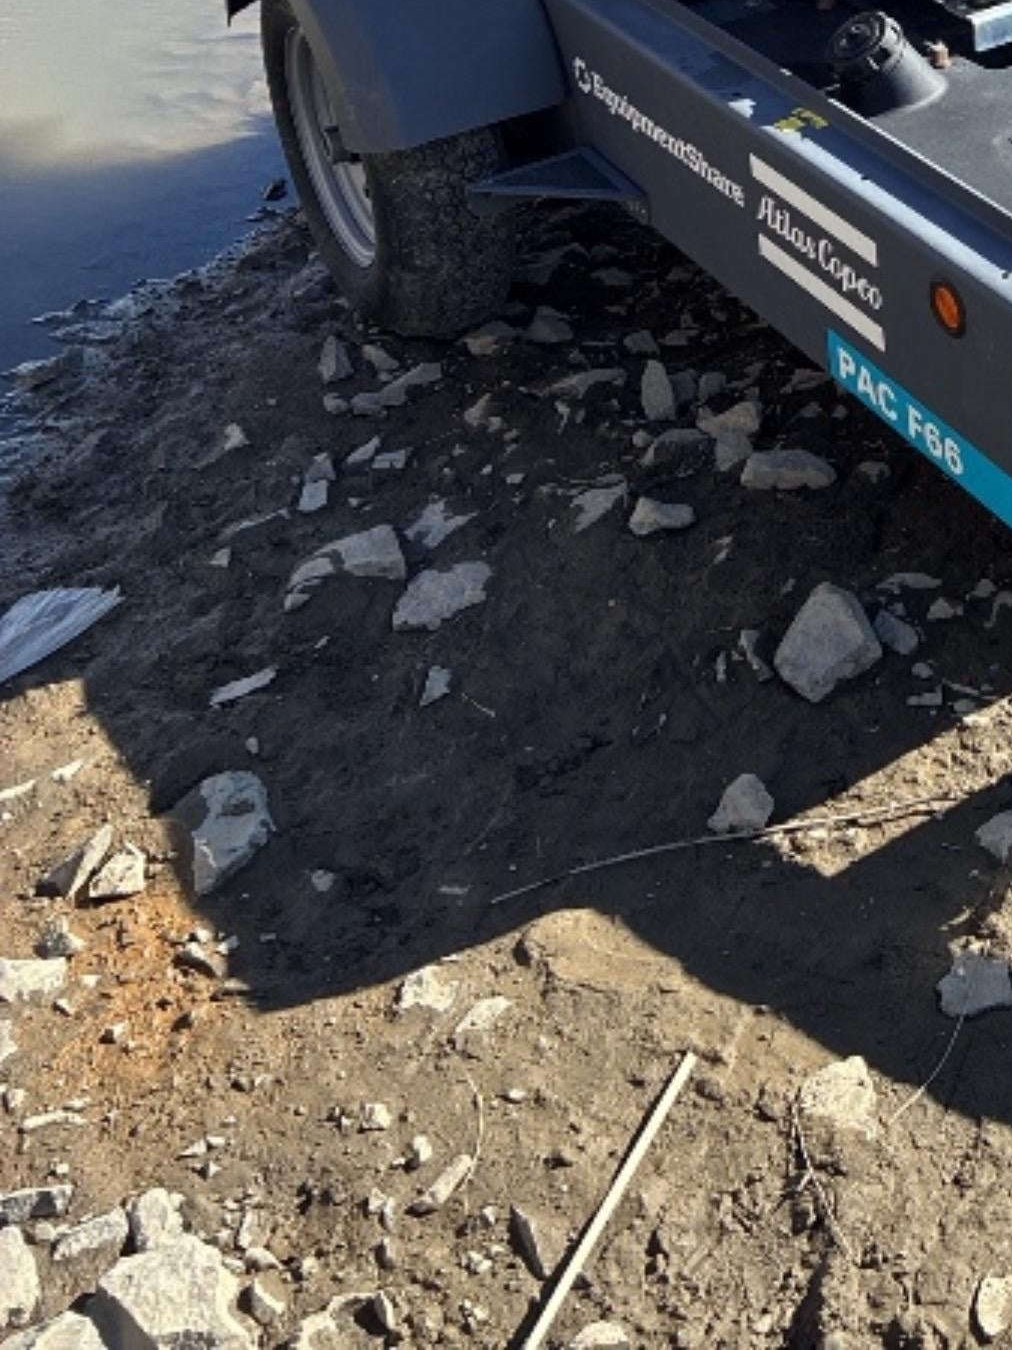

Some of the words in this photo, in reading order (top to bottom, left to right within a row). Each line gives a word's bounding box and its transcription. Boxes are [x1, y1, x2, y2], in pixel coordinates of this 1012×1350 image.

[590, 69, 745, 208] EquipmentShare
[756, 196, 816, 259] Atlas
[817, 238, 883, 310] Copco
[838, 346, 898, 421] PAC
[906, 402, 964, 475] F66
